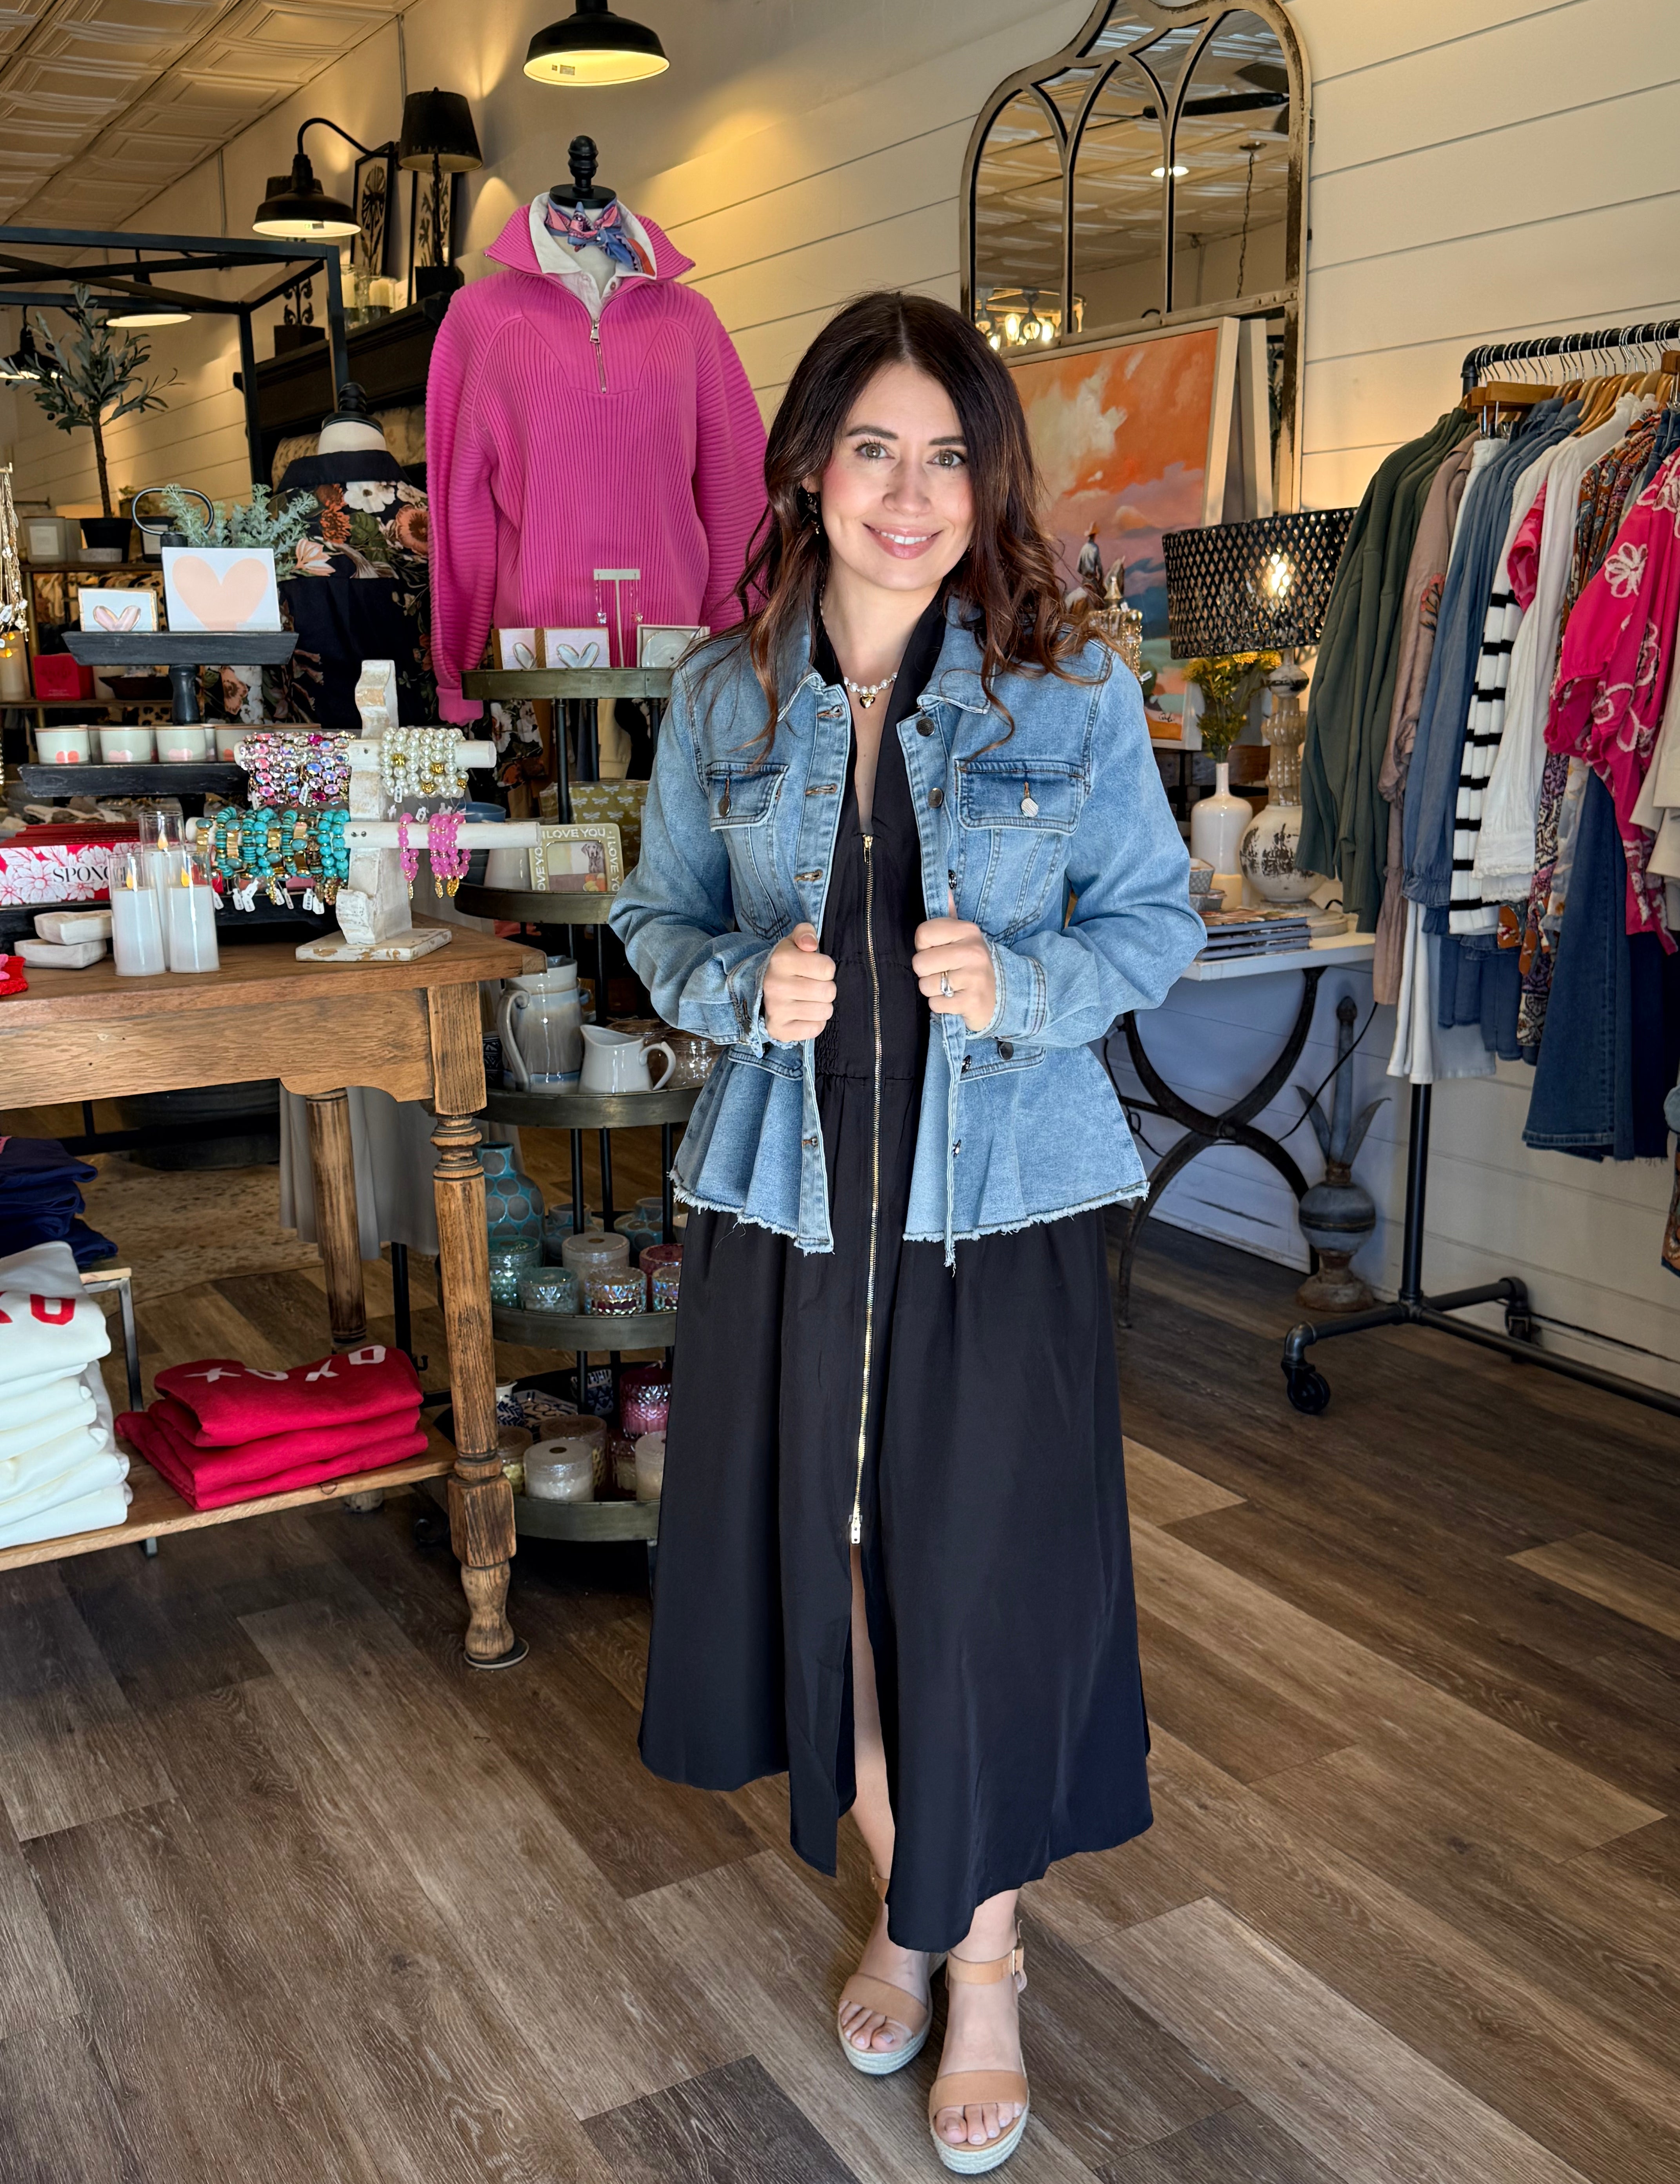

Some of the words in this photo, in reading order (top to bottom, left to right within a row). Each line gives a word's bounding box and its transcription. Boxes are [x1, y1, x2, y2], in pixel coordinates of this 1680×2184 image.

[542, 831, 545, 839] I
[546, 829, 579, 839] LOVE
[580, 828, 605, 838] YOU
[534, 842, 544, 865] YO
[607, 841, 619, 874] LOVE
[536, 866, 545, 891] OVE
[611, 876, 620, 891] YO
